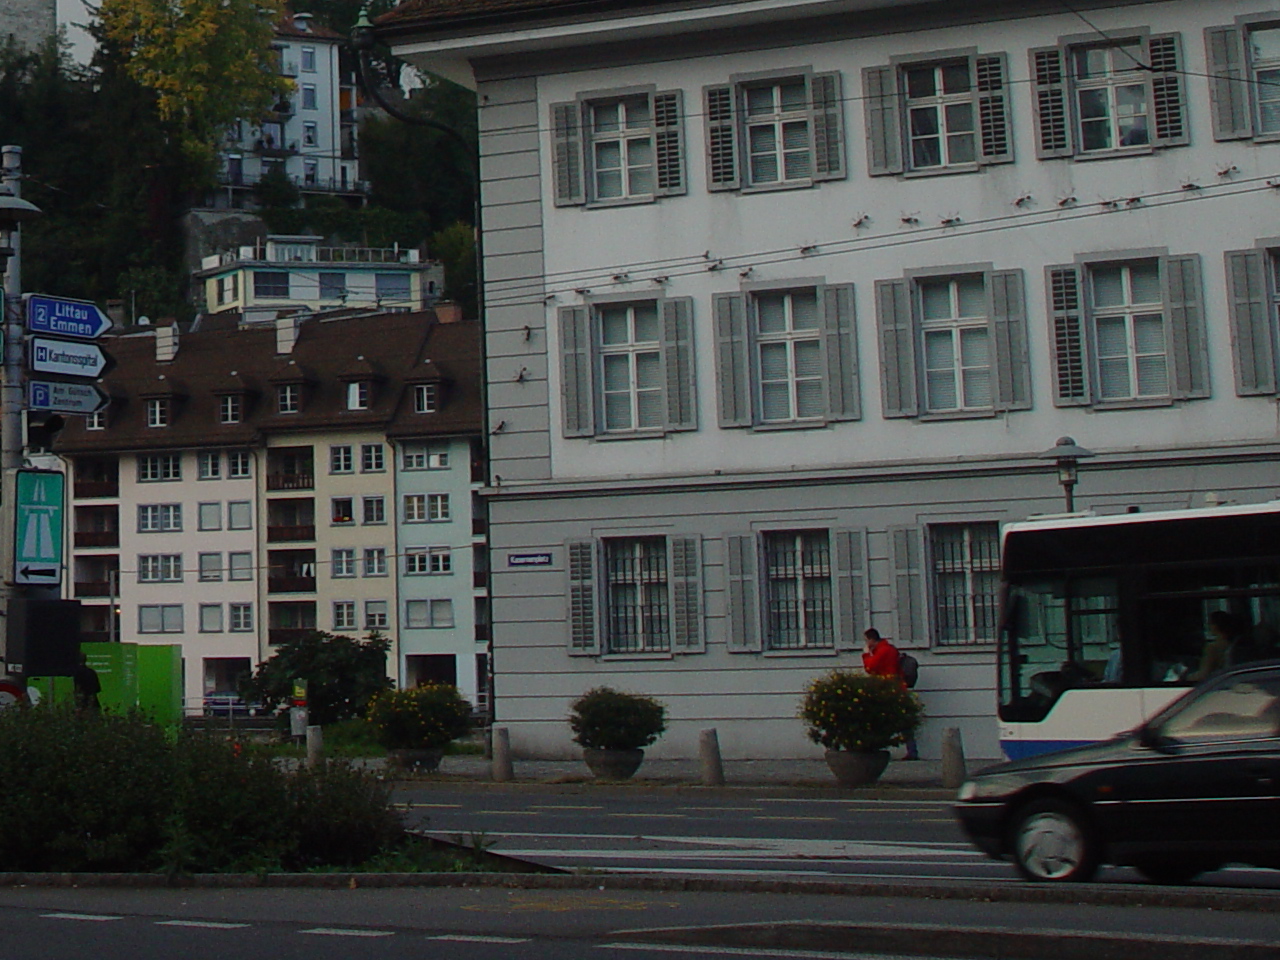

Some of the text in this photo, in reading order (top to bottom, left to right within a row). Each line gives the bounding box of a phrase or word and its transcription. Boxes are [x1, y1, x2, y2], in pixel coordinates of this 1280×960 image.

[37, 310, 46, 323] 2
[55, 302, 89, 320] Littau
[49, 318, 92, 335] Emmen
[37, 348, 46, 361] H
[48, 348, 98, 369] Kantonsspital
[36, 390, 45, 404] P
[53, 396, 83, 407] Zentrum
